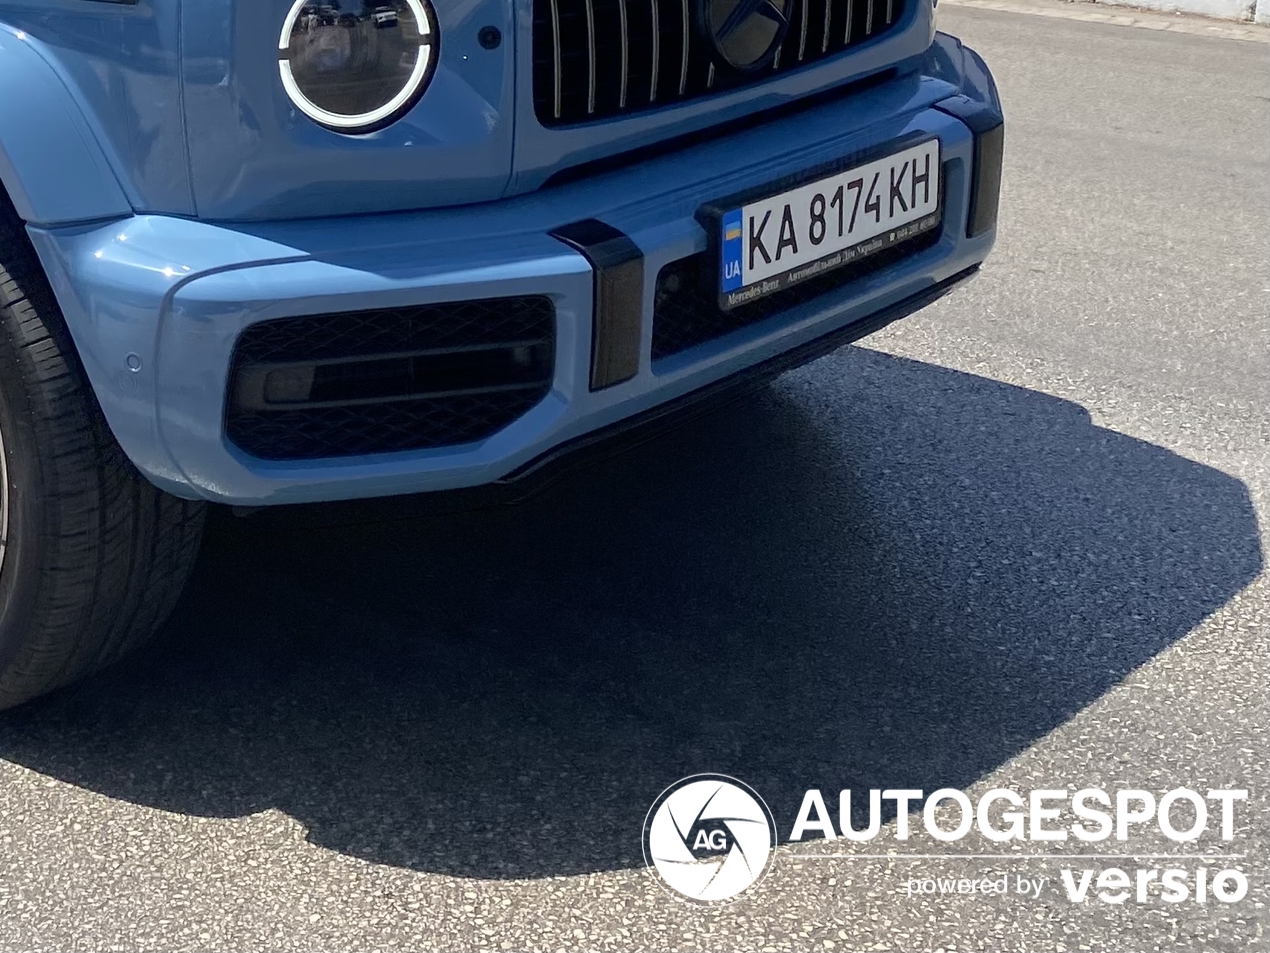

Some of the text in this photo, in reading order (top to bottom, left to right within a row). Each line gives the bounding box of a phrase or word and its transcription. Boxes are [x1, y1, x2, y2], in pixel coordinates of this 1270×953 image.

[748, 153, 930, 270] KA 8174 KH
[725, 260, 741, 279] UA
